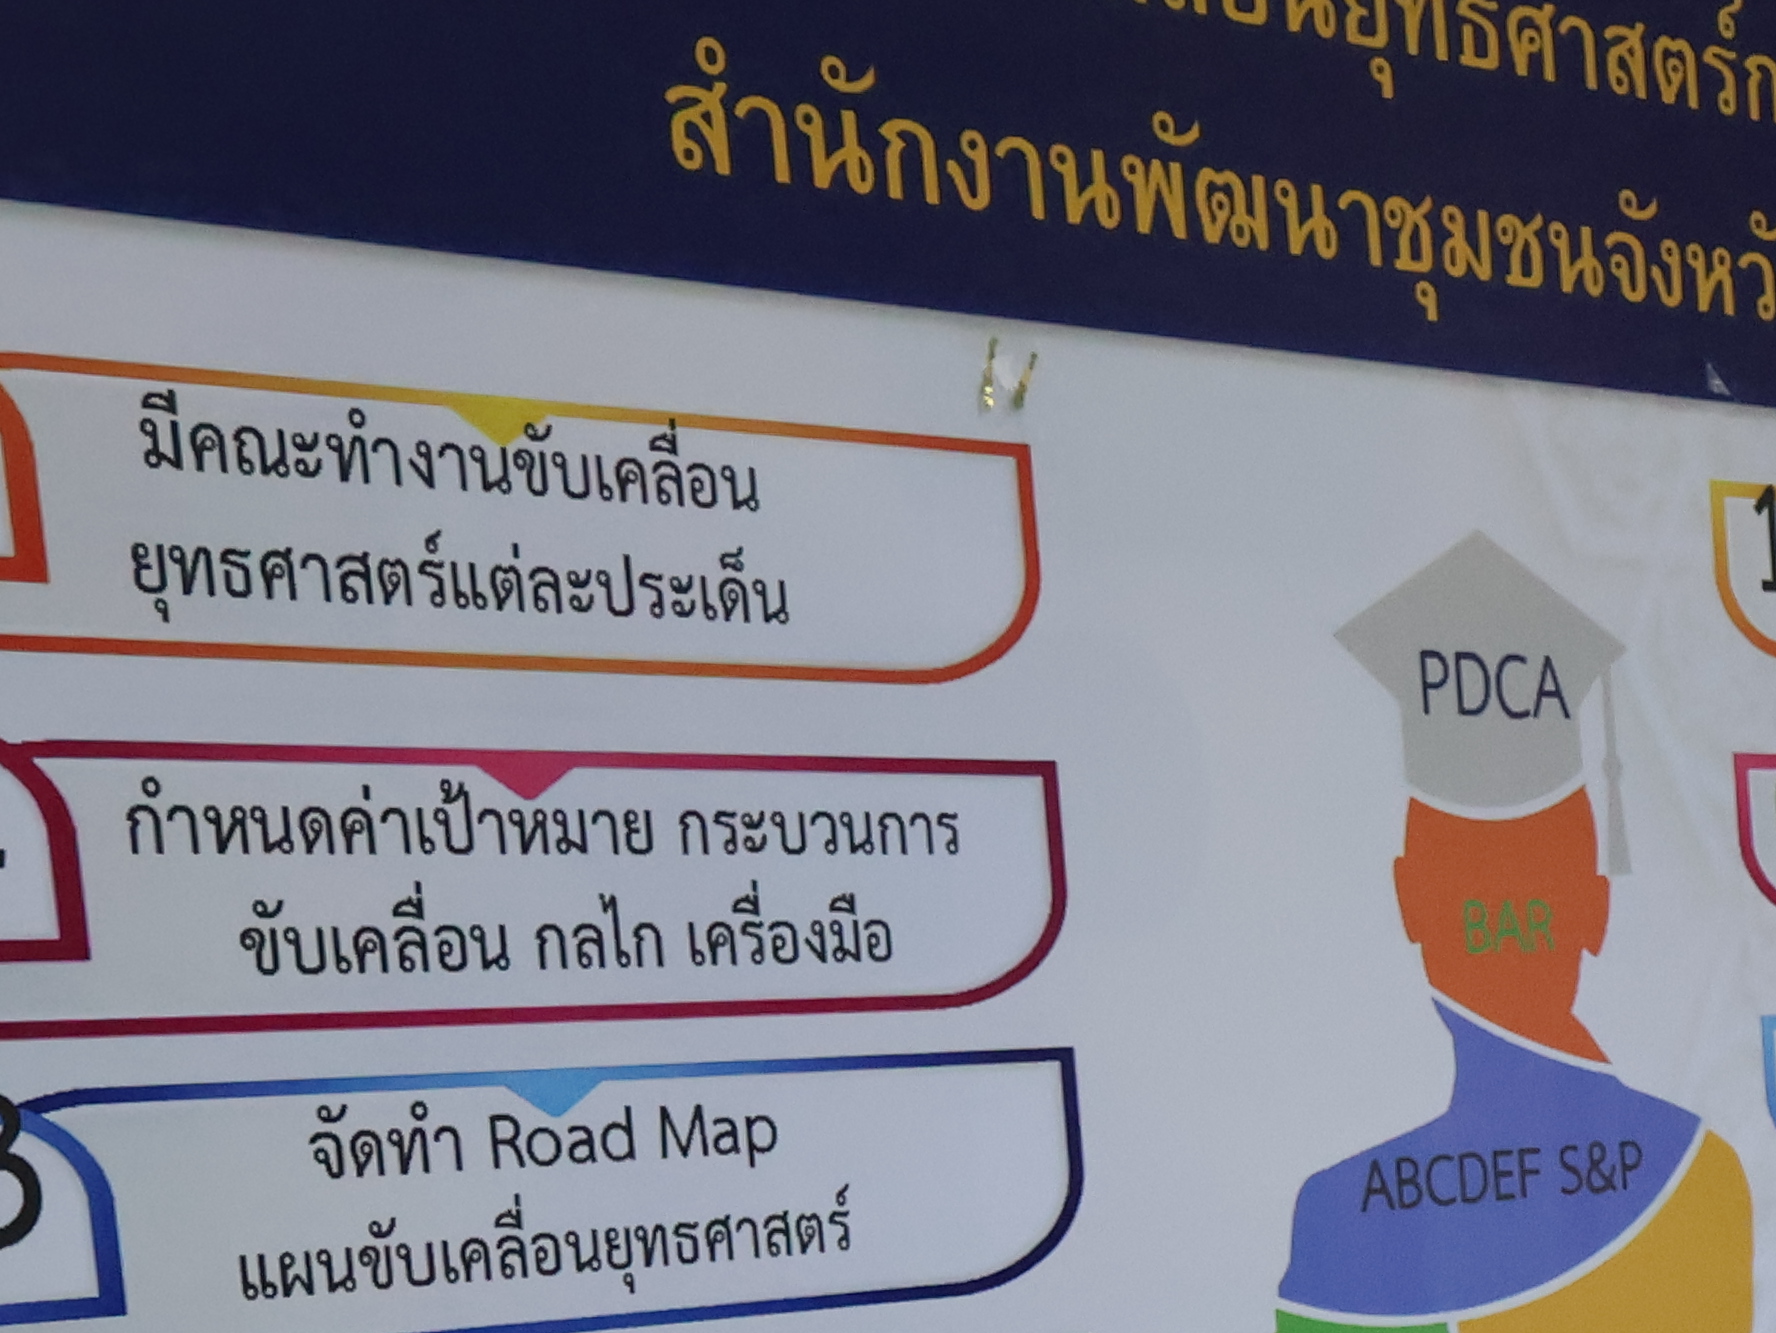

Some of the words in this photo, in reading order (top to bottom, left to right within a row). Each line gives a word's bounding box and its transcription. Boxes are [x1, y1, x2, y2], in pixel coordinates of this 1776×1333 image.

[140, 390, 760, 515] มีคณะทำงานขับเคลื่อน
[130, 530, 790, 627] ยุทธศาสตร์แต่ละประเด็น
[1419, 648, 1572, 722] PDCA
[127, 775, 654, 859] กำหนดค่าเป้าหมาย
[678, 800, 962, 859] กระบวนการ
[240, 881, 511, 976] ขับเคลื่อน
[534, 896, 666, 973] กลไก
[688, 891, 895, 970] เครื่องมือ
[1462, 898, 1556, 956] BAR
[308, 1105, 463, 1181] จัดทำ
[490, 1107, 636, 1174] Road
[659, 1103, 779, 1169] Map
[1361, 1143, 1542, 1215] ABCDEF
[1560, 1138, 1645, 1197] S&P
[239, 1184, 854, 1302] แผนขับเคลื่อนยุทธศาสตร์
